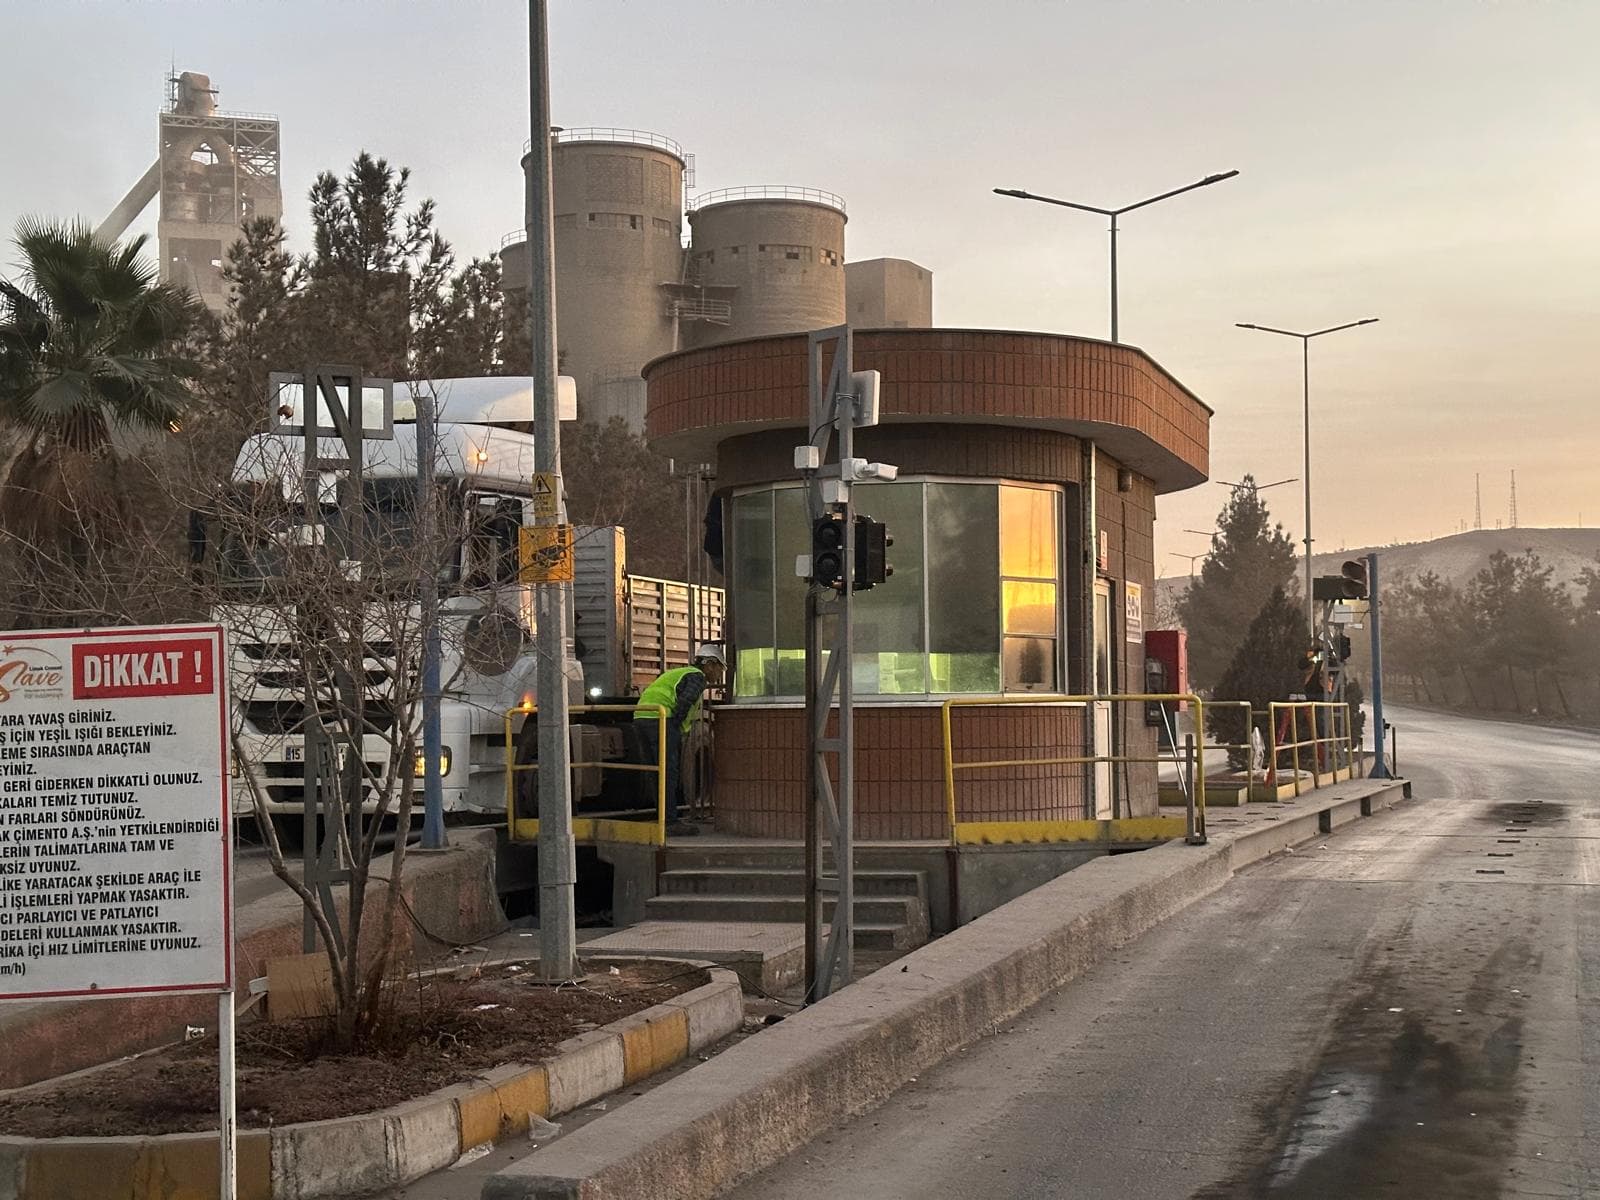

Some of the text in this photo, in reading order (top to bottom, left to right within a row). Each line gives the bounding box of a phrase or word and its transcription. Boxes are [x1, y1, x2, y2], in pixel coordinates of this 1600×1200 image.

[194, 651, 202, 683] !
[28, 712, 65, 727] YAVAŞ
[69, 709, 115, 723] GİRİNİZ.
[10, 729, 35, 745] İÇİN
[39, 727, 71, 743] YEŞİL
[75, 727, 102, 742] IŞIĞI
[107, 723, 177, 738] BEKLEYİNİZ.
[0, 742, 150, 760] EME SIRASINDA ARAÇTAN
[291, 748, 301, 760] 15
[4, 772, 203, 792] GERİ GİDERKEN DİKKATLİ OLUNUZ.
[41, 793, 77, 807] TEMİZ
[81, 792, 138, 805] TUTUNUZ.
[9, 812, 57, 825] FARLARI
[62, 808, 145, 822] SÖNDÜRÜNÜZ.
[0, 830, 10, 843] K
[14, 828, 67, 844] ÇİMENTO
[120, 817, 219, 836] YETKİLENDİRDİĞİ
[0, 839, 174, 858] ERİN TALİMATLARINA TAM VE
[0, 860, 80, 875] KSİZ UYUNUZ.
[0, 869, 201, 891] İKE YARATACAK ŞEKİLDE ARAÇ İLE
[0, 888, 189, 910] İ İŞLEMLERİ YAPMAK YASAKTIR.
[1, 907, 159, 925] CI PARLAYICI VE PATLAYICI
[1, 922, 181, 941] DELERİ KULLANMAK YASAKTIR.
[28, 942, 44, 959] İÇİ
[48, 944, 68, 956] HIZ
[72, 939, 146, 954] LİMİTLERİNE
[151, 937, 200, 950] UYUNUZ.
[1, 963, 26, 976] m/h)
